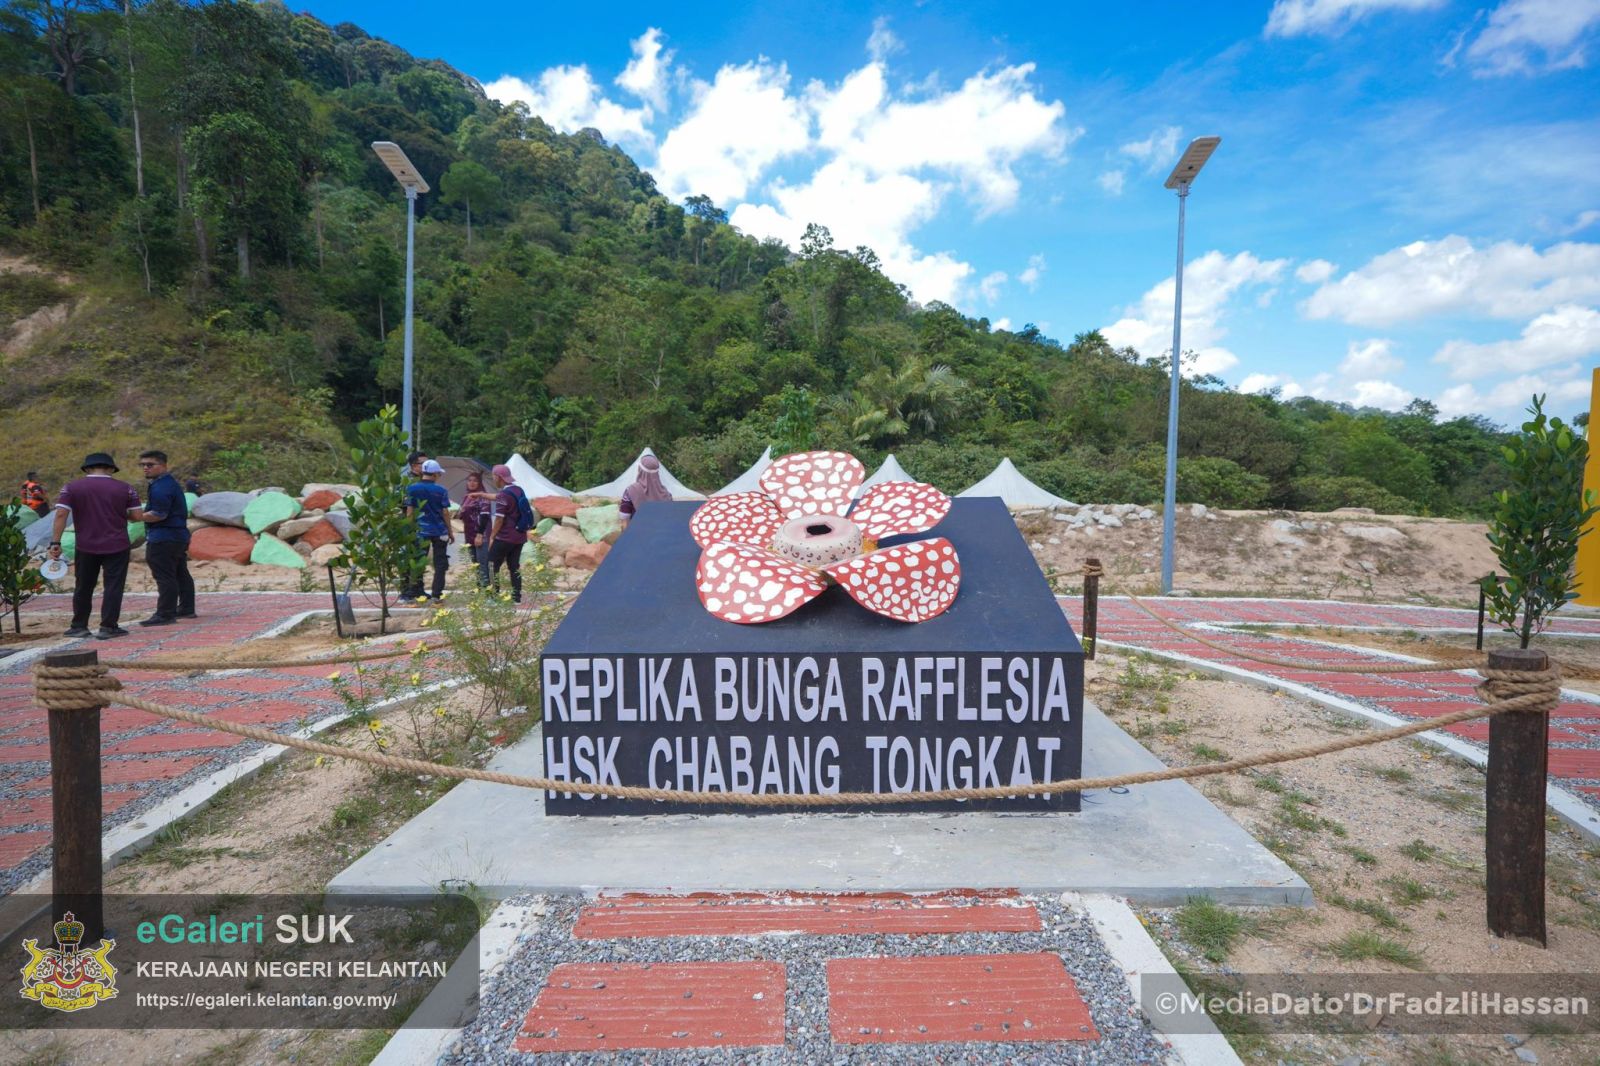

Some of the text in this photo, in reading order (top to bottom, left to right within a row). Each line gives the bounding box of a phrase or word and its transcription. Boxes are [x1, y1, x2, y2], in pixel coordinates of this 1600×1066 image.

[543, 656, 1070, 723] REPLIKA BUNGA RAFFLESIA
[546, 735, 1061, 801] HSK CHABANG TONGKAT
